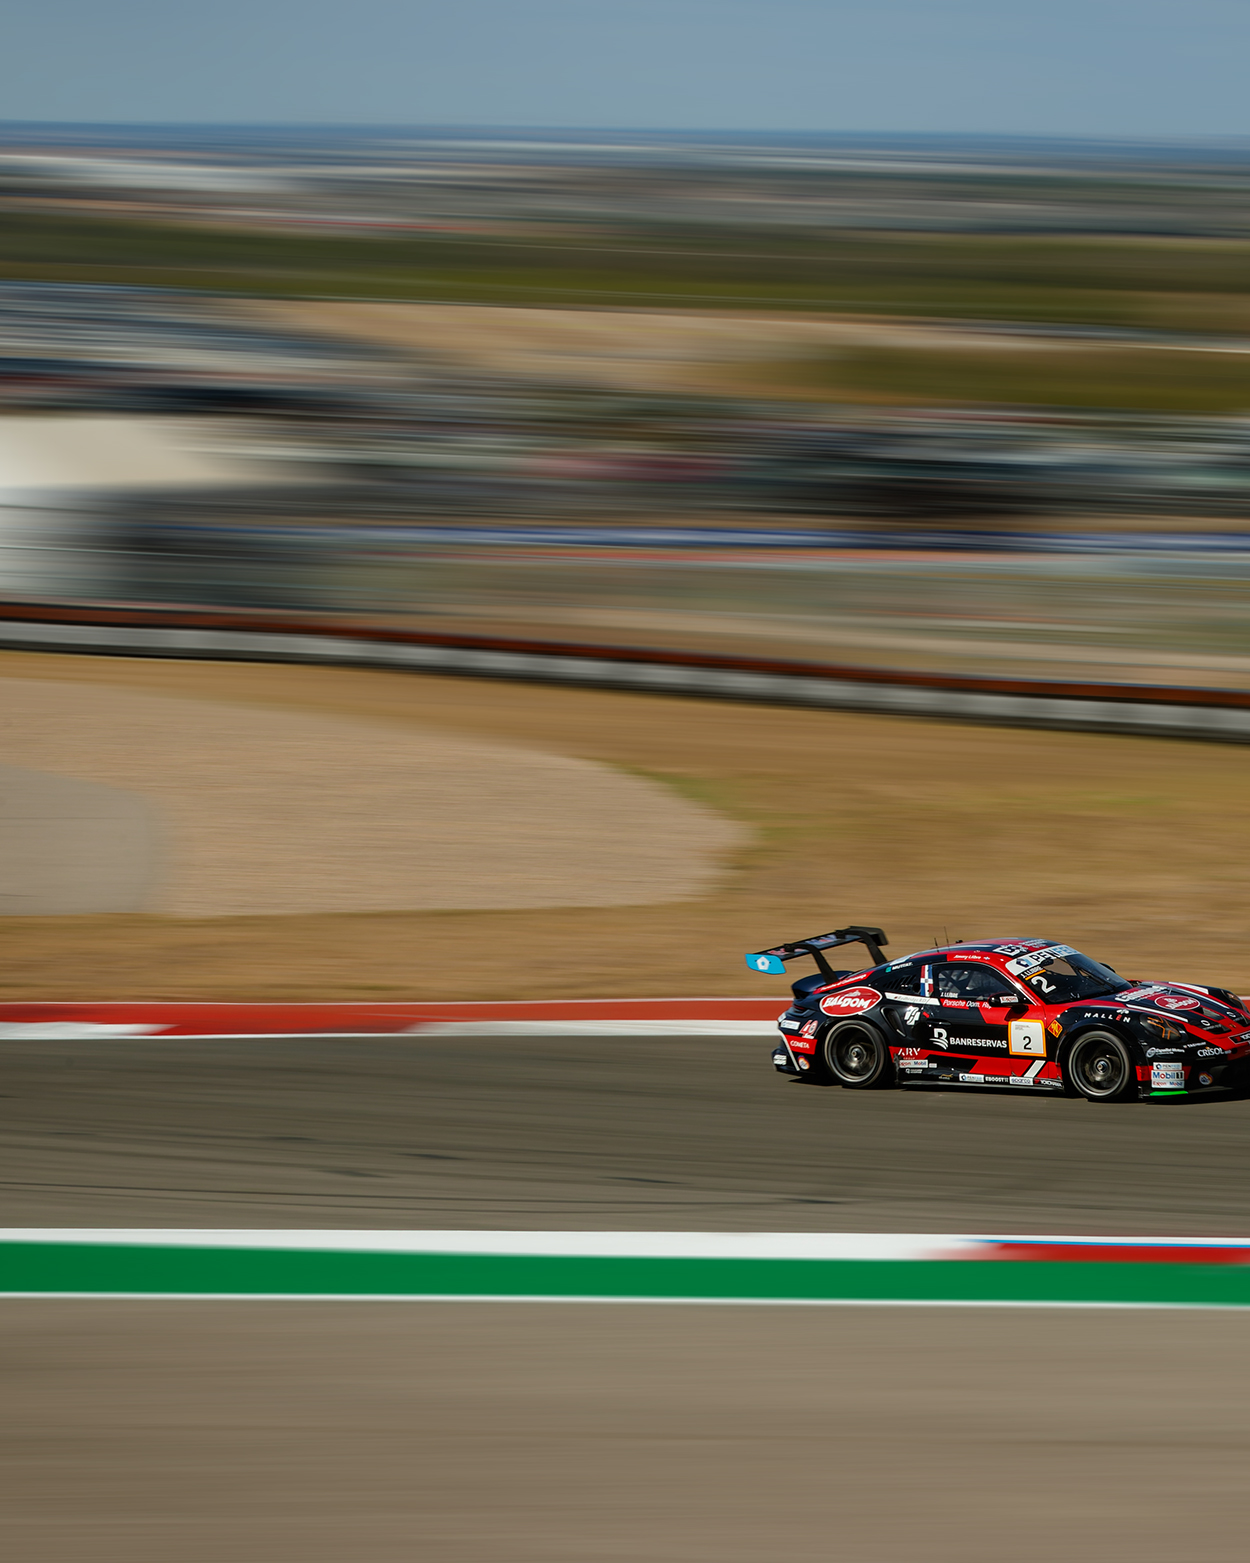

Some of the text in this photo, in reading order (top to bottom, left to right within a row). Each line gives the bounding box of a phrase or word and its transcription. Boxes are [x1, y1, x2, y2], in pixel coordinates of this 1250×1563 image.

[1031, 975, 1057, 994] 2
[822, 995, 873, 1009] BALDOM
[790, 1040, 810, 1049] COMETA
[949, 1037, 1008, 1049] BANRESERVAS
[1022, 1035, 1032, 1050] 2
[1197, 1047, 1224, 1057] CRISOL
[1152, 1071, 1175, 1079] Mobil
